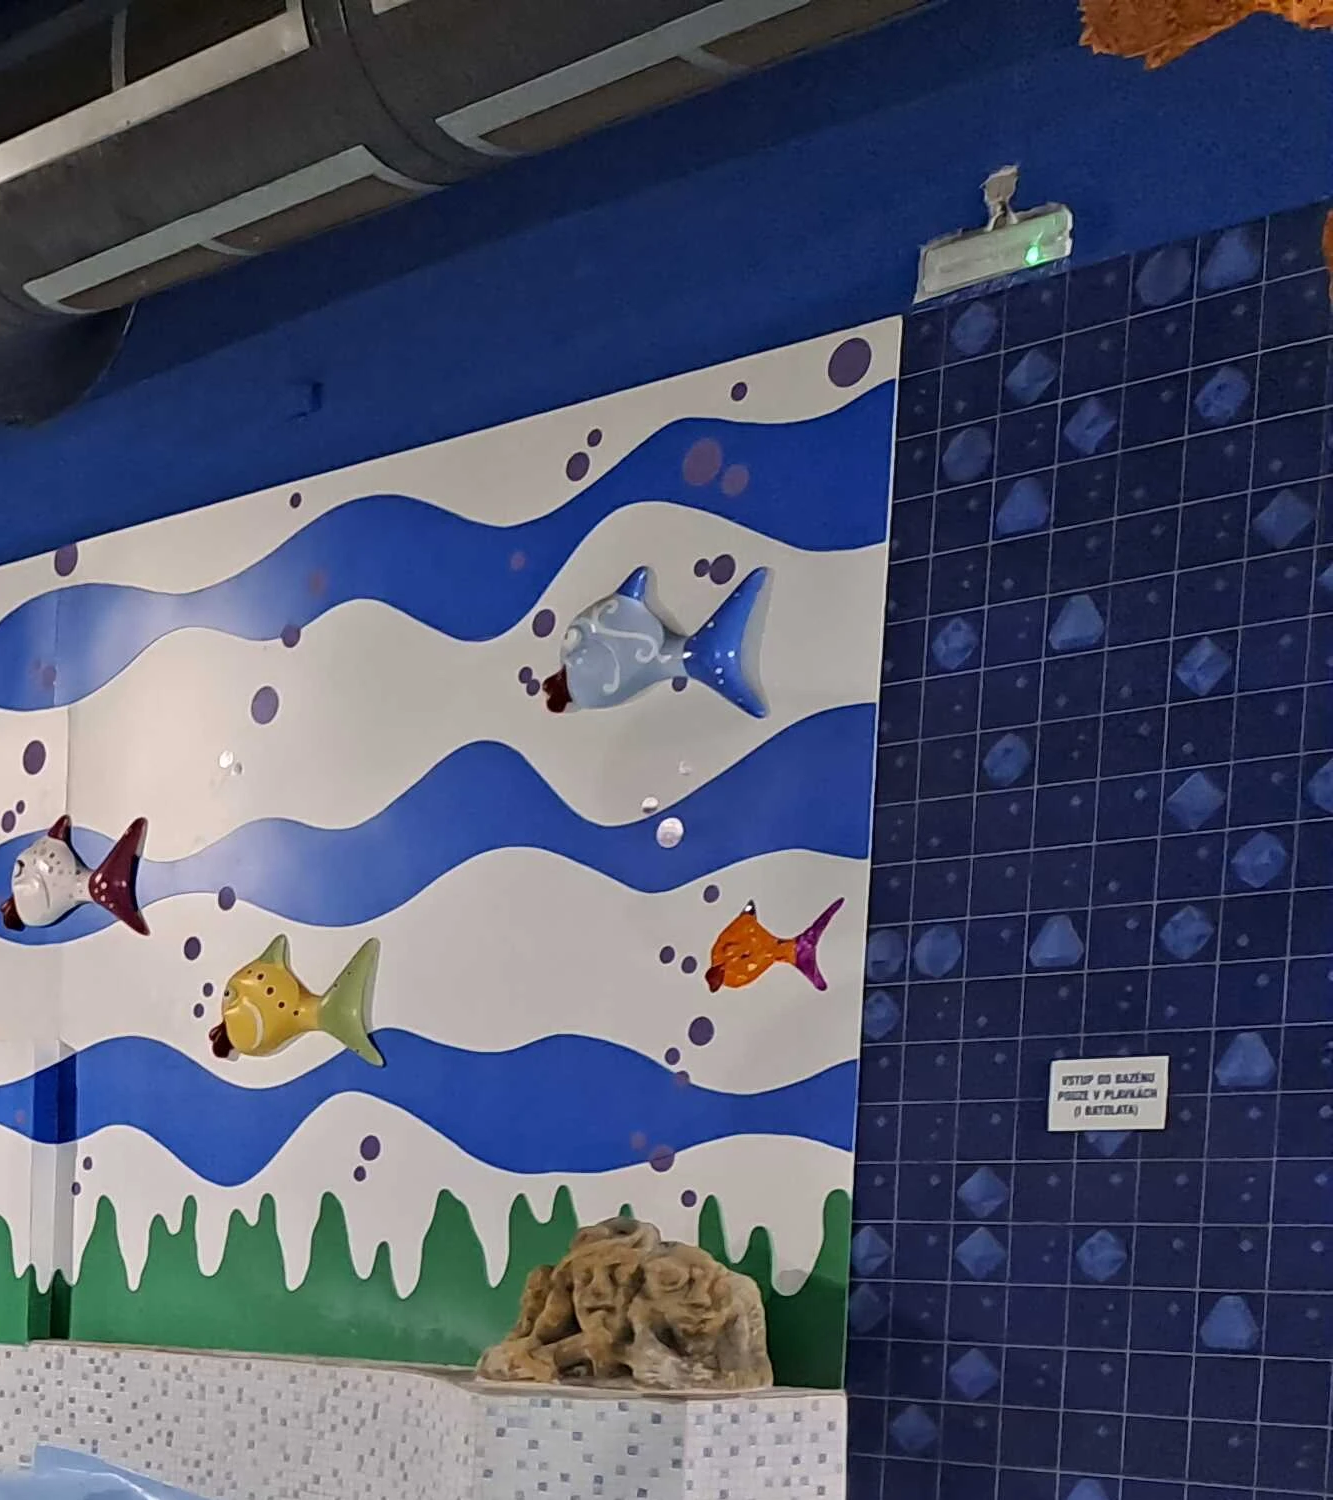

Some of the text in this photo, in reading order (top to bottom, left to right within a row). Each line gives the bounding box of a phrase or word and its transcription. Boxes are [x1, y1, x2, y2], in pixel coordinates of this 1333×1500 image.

[1061, 1074, 1094, 1086] VSTUP
[1115, 1071, 1156, 1084] BAZÉNU
[1093, 1090, 1100, 1100] V
[1104, 1086, 1158, 1100] PLAVKÁCH
